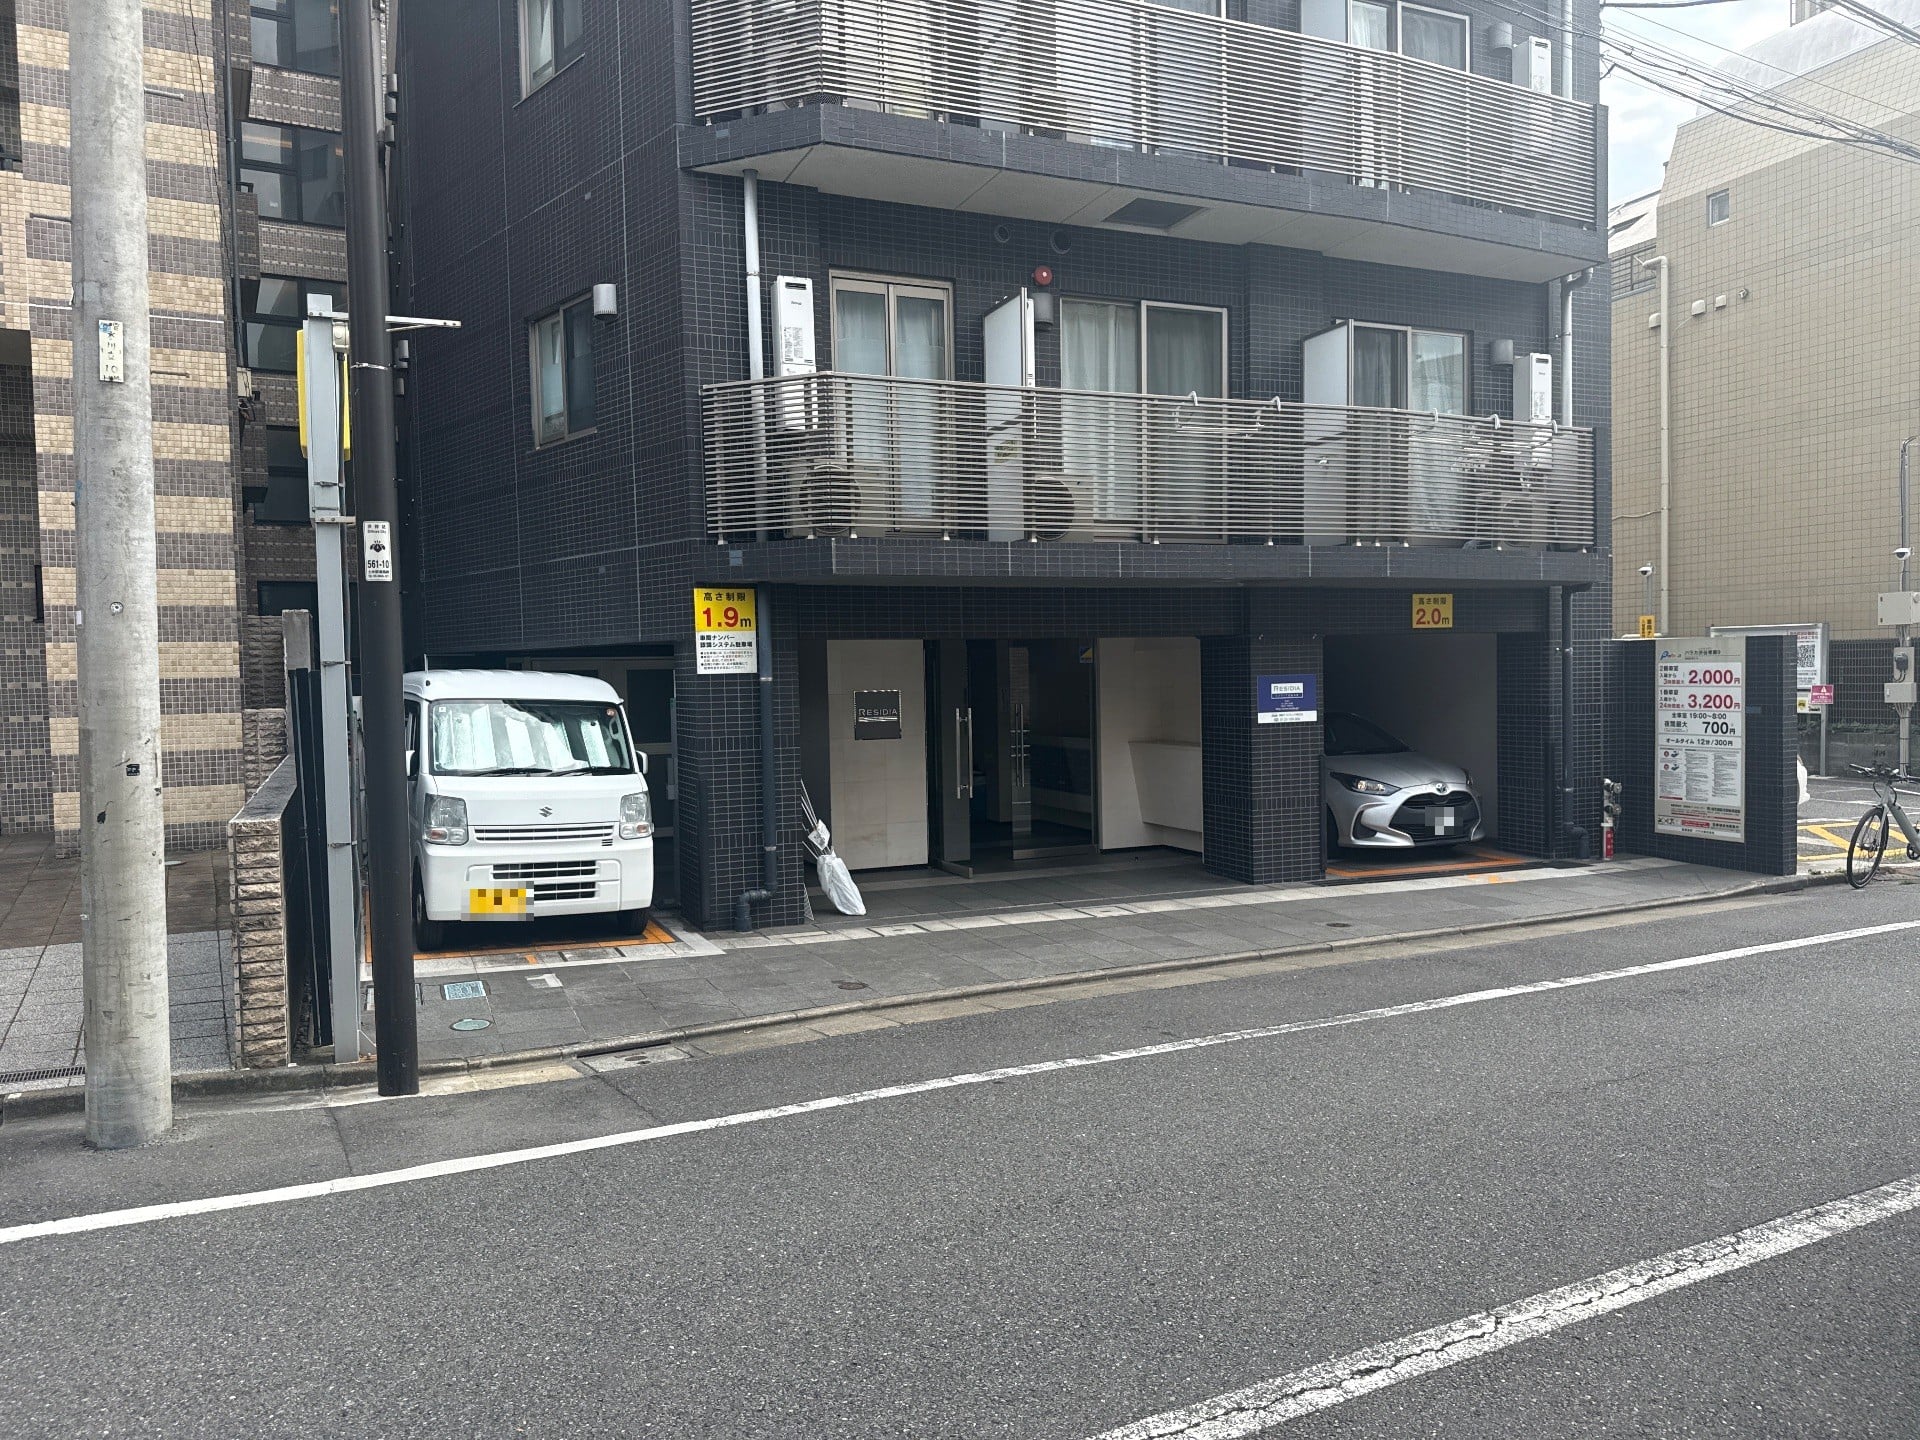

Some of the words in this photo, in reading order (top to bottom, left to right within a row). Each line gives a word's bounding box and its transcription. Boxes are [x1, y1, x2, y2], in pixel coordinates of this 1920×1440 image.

[367, 560, 389, 568] 561-10
[703, 592, 746, 602] 高さ制限
[702, 606, 751, 628] 1.9m
[1415, 608, 1450, 625] 2.0m
[1688, 669, 1741, 685] 2,000円
[1687, 694, 1741, 710] 3,200円
[858, 708, 898, 717] RESIDIA
[1701, 721, 1736, 735] 700円
